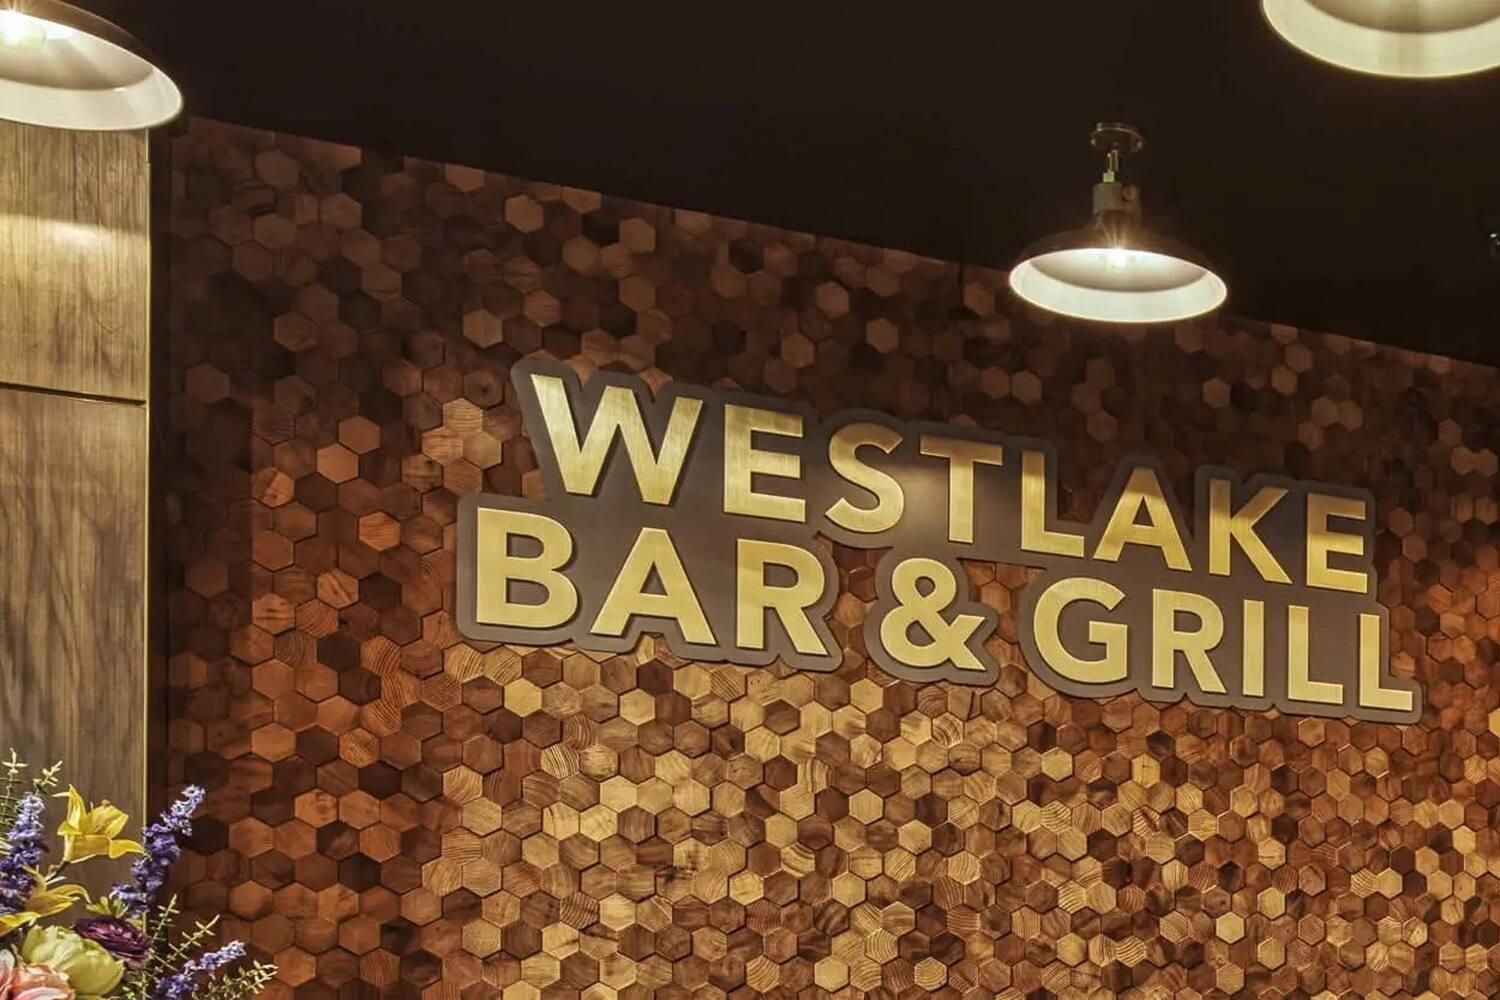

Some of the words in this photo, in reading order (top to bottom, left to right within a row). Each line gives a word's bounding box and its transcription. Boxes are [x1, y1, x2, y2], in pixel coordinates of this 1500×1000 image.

[530, 373, 1370, 593] WESTLAKE
[475, 507, 829, 654] BAR
[880, 558, 987, 671] &
[1033, 577, 1413, 711] GRILL
